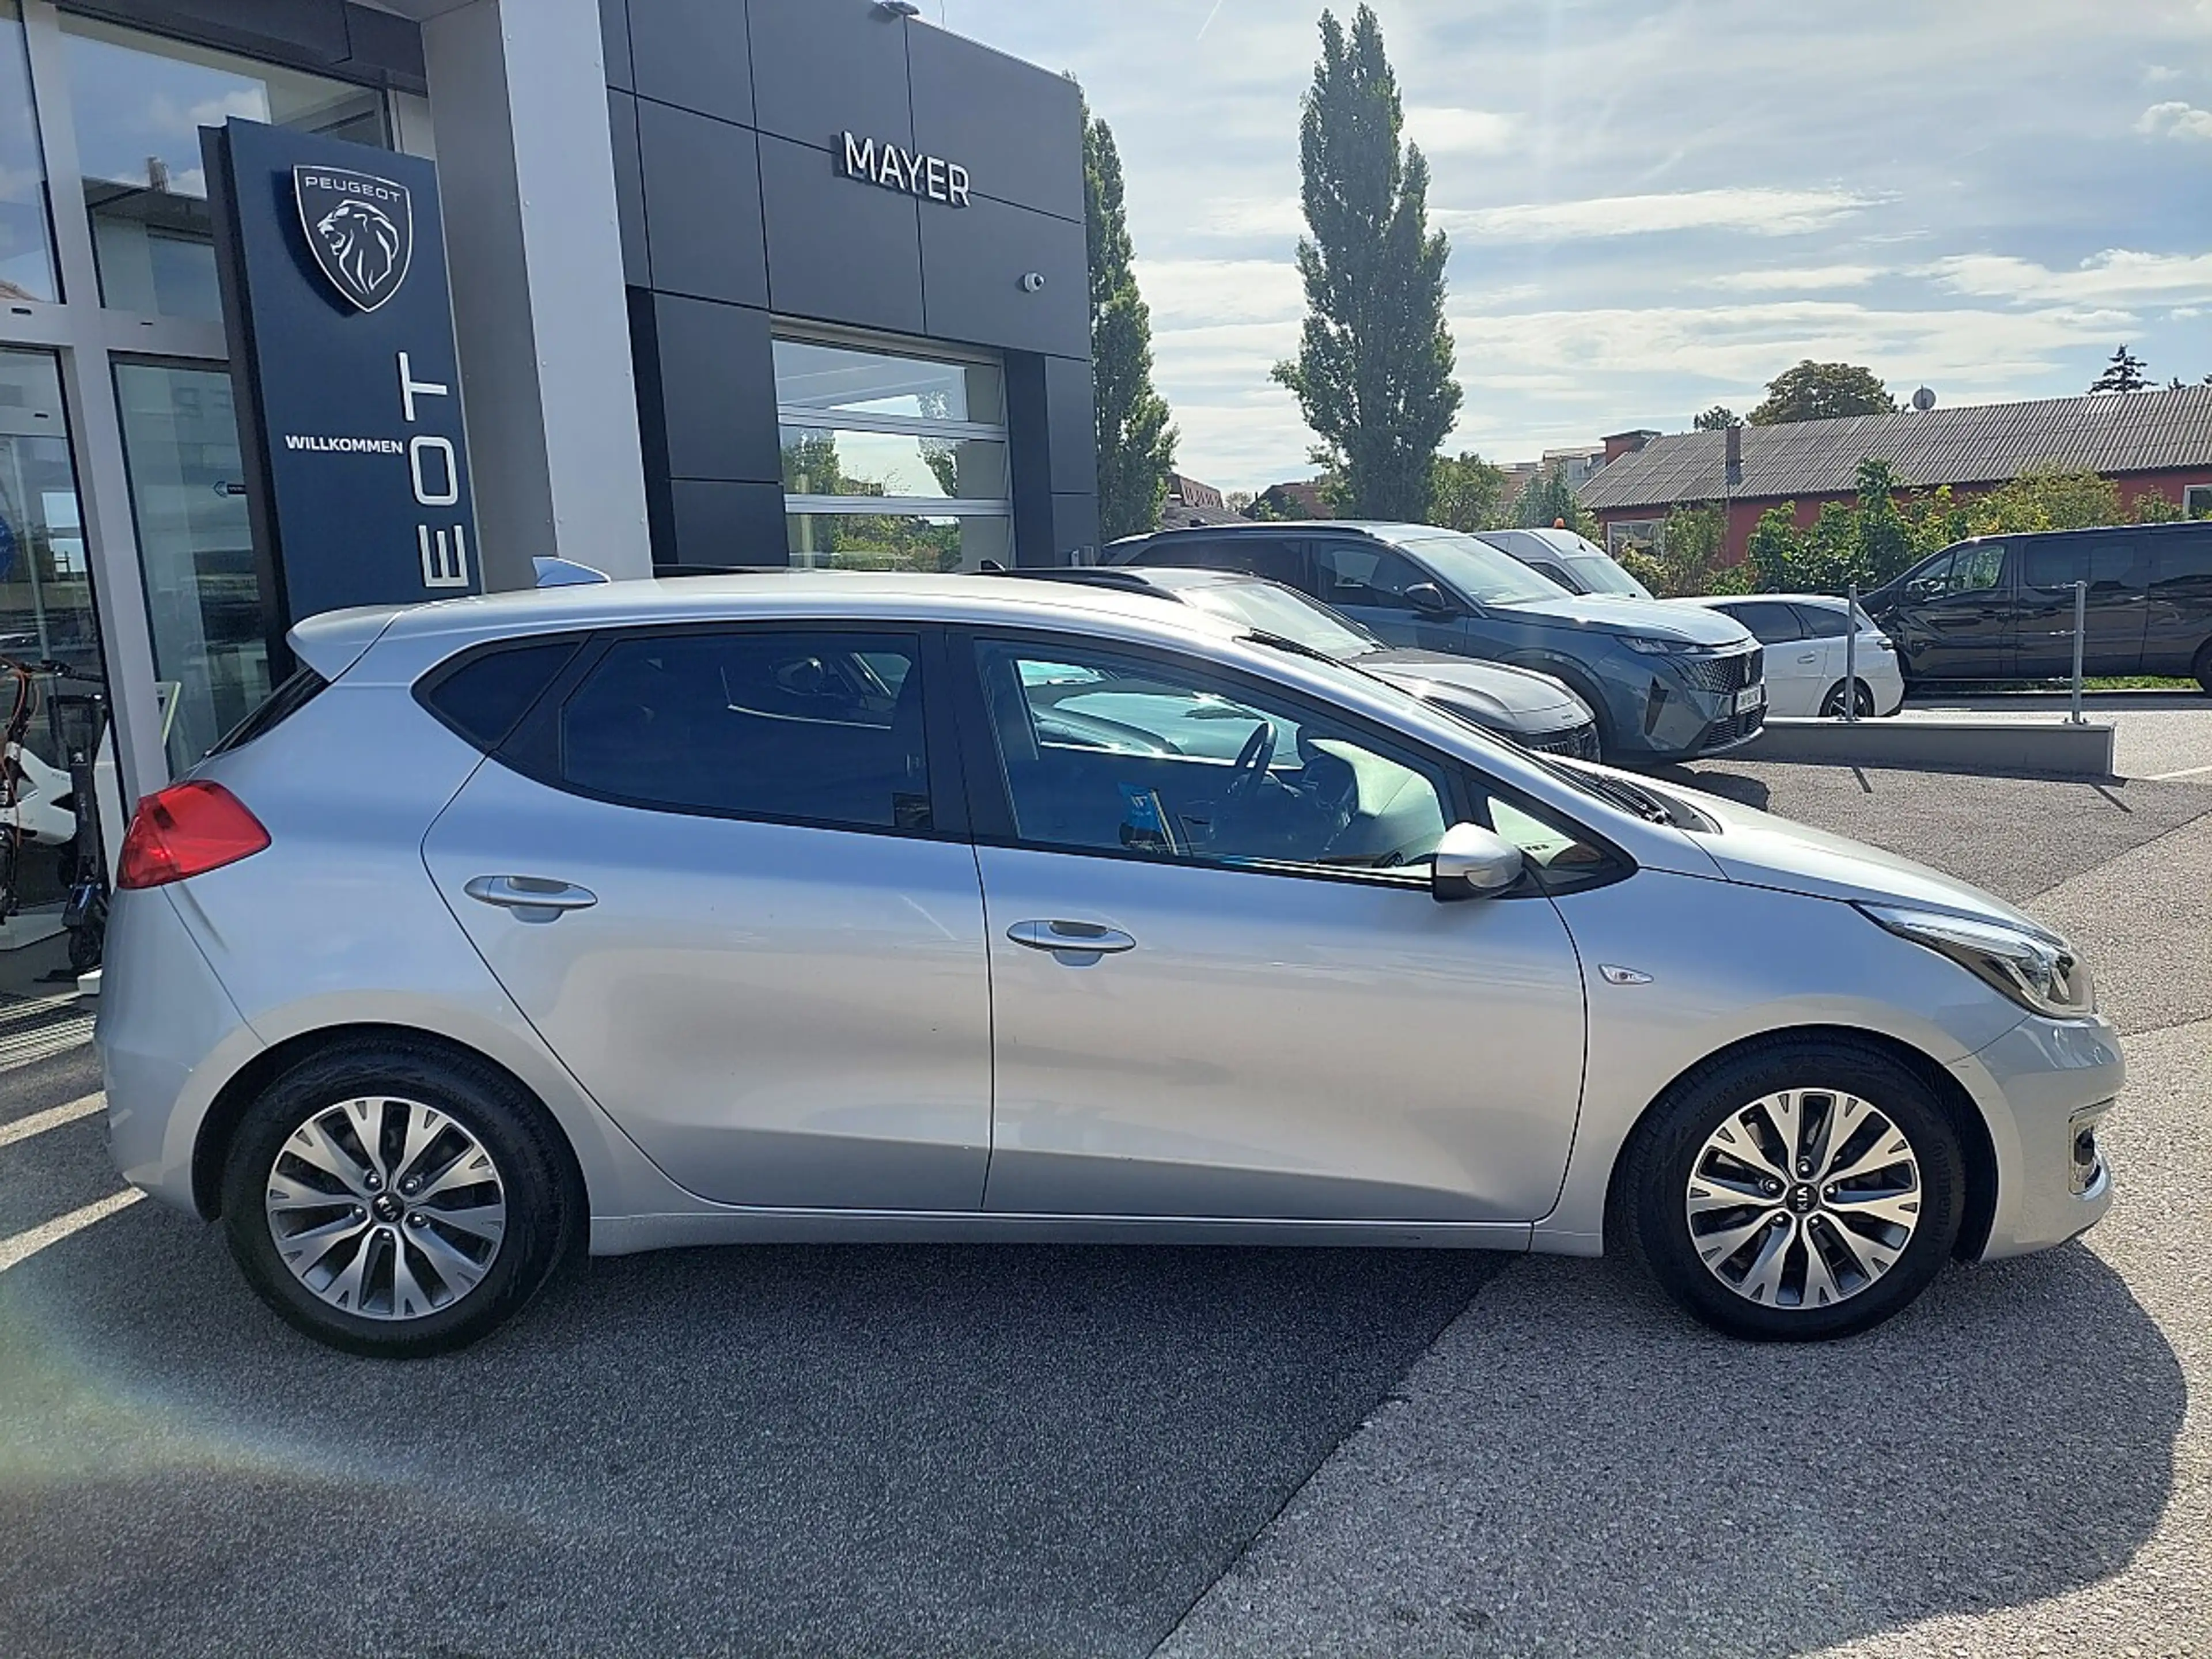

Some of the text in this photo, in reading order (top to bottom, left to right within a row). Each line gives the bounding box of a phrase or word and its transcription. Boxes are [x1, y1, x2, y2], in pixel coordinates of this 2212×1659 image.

[843, 130, 971, 207] MAYER
[305, 176, 401, 202] PEUGEOT
[286, 434, 403, 454] WILLKOMMEN
[377, 1196, 397, 1221] KIA
[1797, 1187, 1808, 1211] KIA
